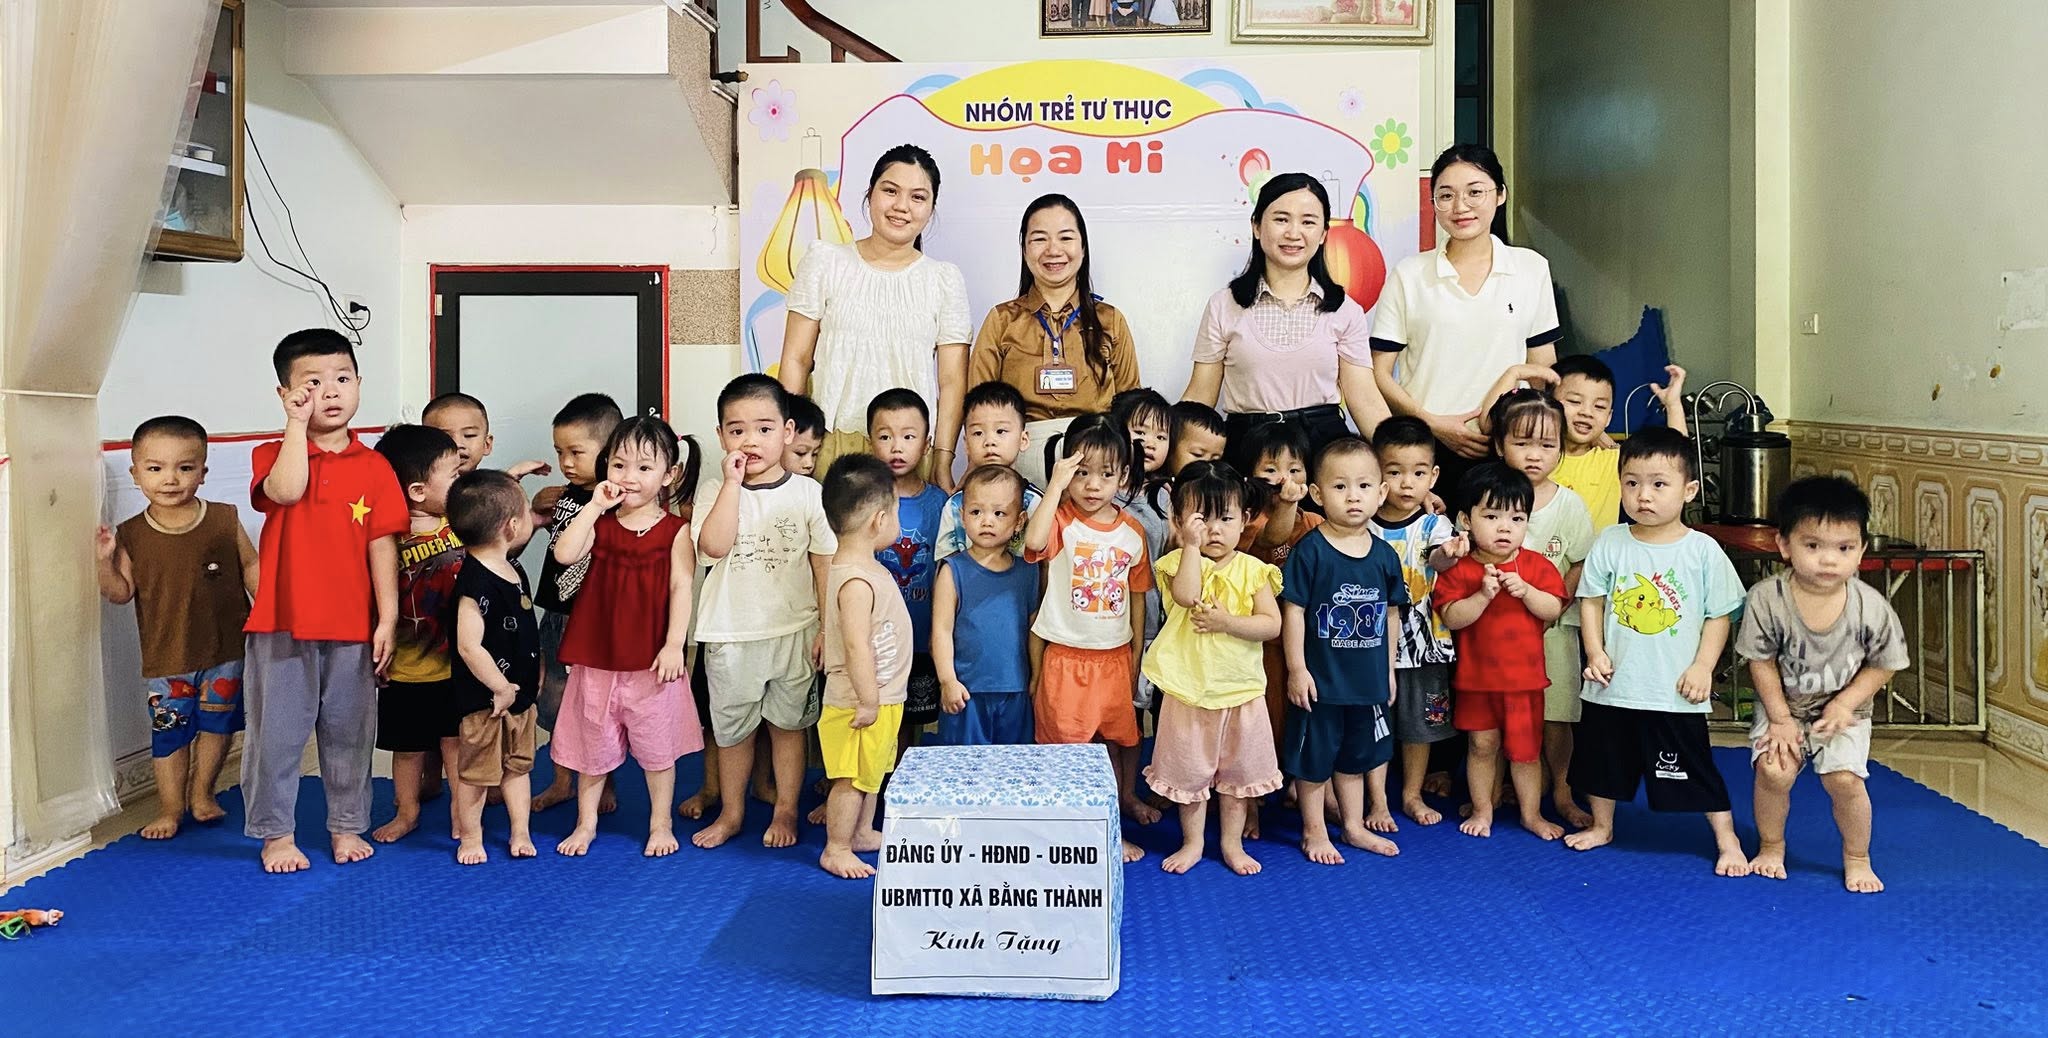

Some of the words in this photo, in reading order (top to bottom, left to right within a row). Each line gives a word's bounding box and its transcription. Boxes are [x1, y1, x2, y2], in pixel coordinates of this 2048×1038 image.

[965, 96, 1033, 122] NHÓM
[1039, 94, 1075, 121] TRẺ
[1081, 97, 1108, 120] TƯ
[1114, 98, 1172, 125] THỤC
[969, 143, 1083, 183] Họa
[1106, 140, 1164, 175] Mi
[1315, 601, 1388, 640] 1987
[886, 839, 935, 864] ĐẢNG
[940, 839, 963, 864] ỦY
[981, 845, 1030, 864] HĐND
[1049, 846, 1098, 865] UBND
[881, 888, 954, 908] UBMTTQ
[959, 885, 983, 907] XÃ
[989, 881, 1038, 907] BẰNG
[1043, 884, 1103, 908] THÀNH
[995, 930, 1062, 955] Tặng
